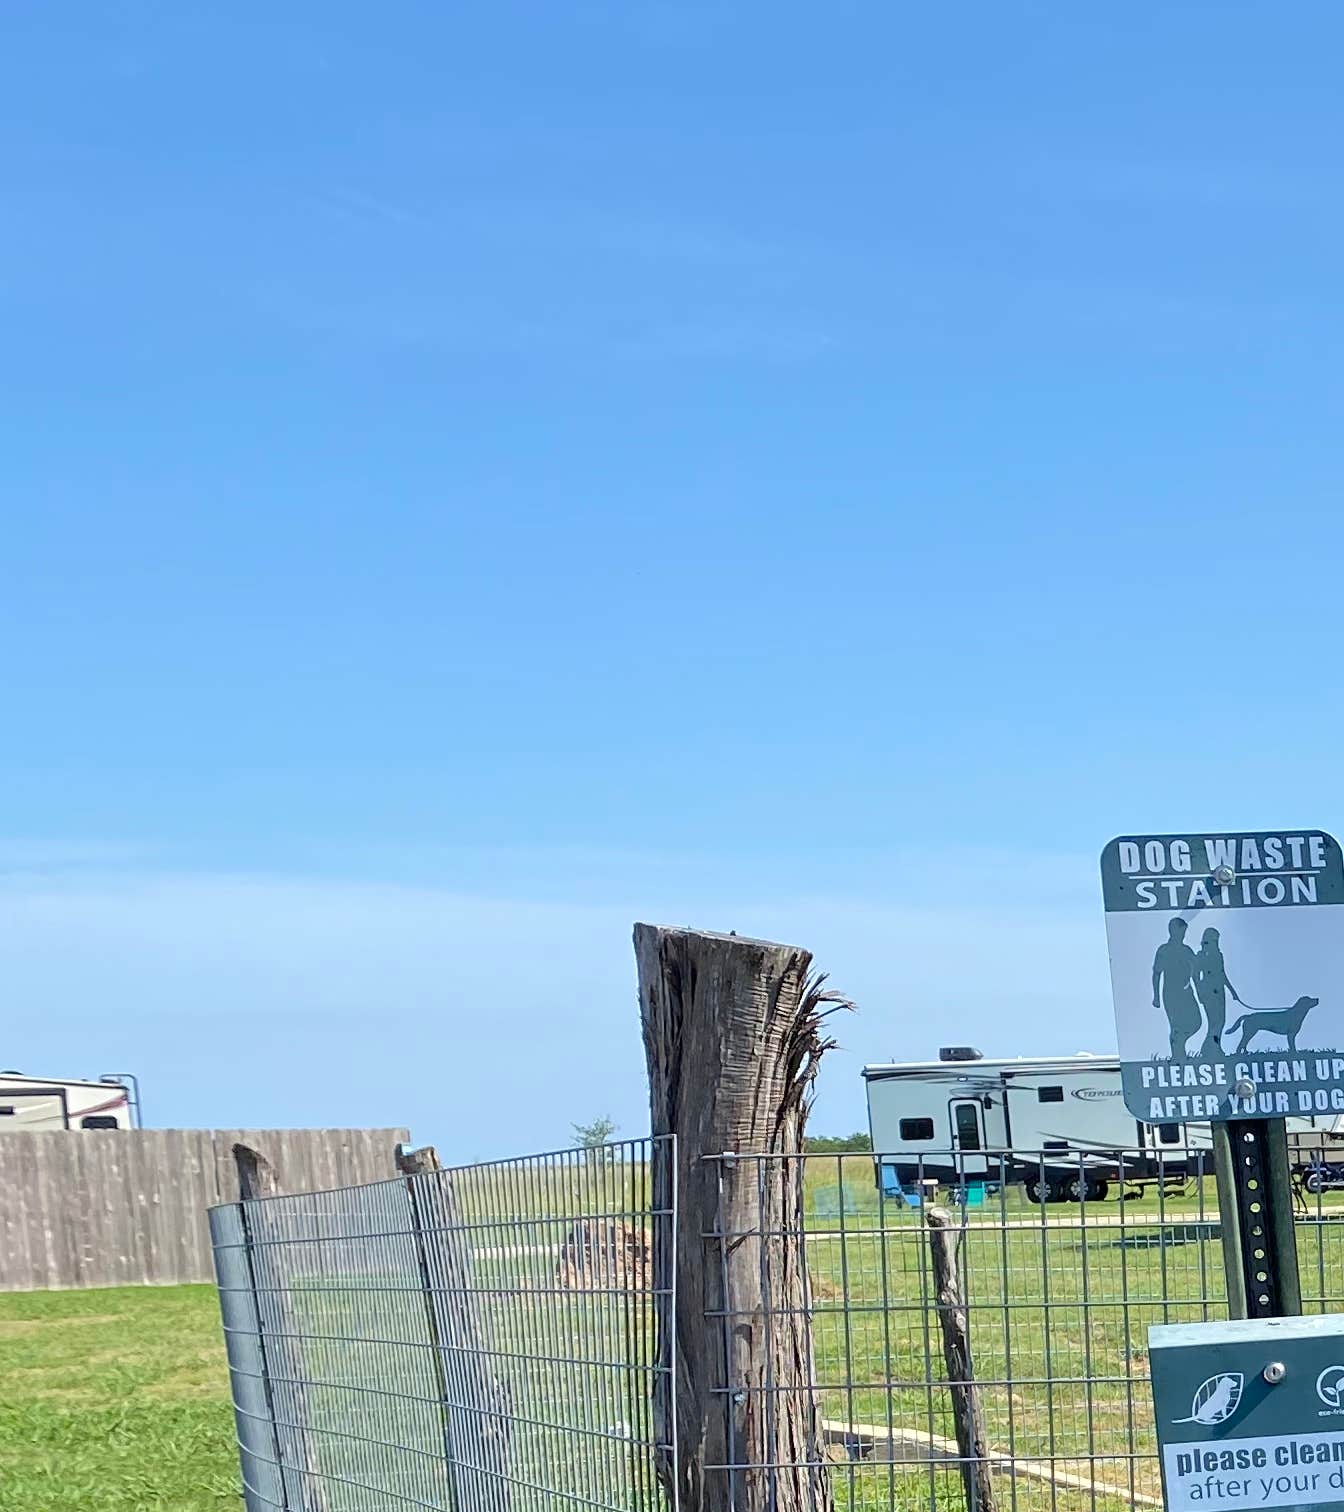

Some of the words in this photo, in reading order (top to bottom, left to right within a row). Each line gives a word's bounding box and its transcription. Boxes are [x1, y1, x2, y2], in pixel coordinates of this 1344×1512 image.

[1118, 839, 1192, 873] DOG
[1203, 836, 1327, 871] WASTE
[1135, 877, 1318, 908] STATION
[1141, 1063, 1227, 1088] PLEASE
[1234, 1061, 1307, 1084] CLEAN
[1315, 1058, 1344, 1080] UP
[1150, 1095, 1220, 1119] AFTER
[1227, 1091, 1290, 1115] YOUR
[1176, 1447, 1267, 1477] please
[1189, 1475, 1252, 1500] after
[1259, 1473, 1320, 1501] your
